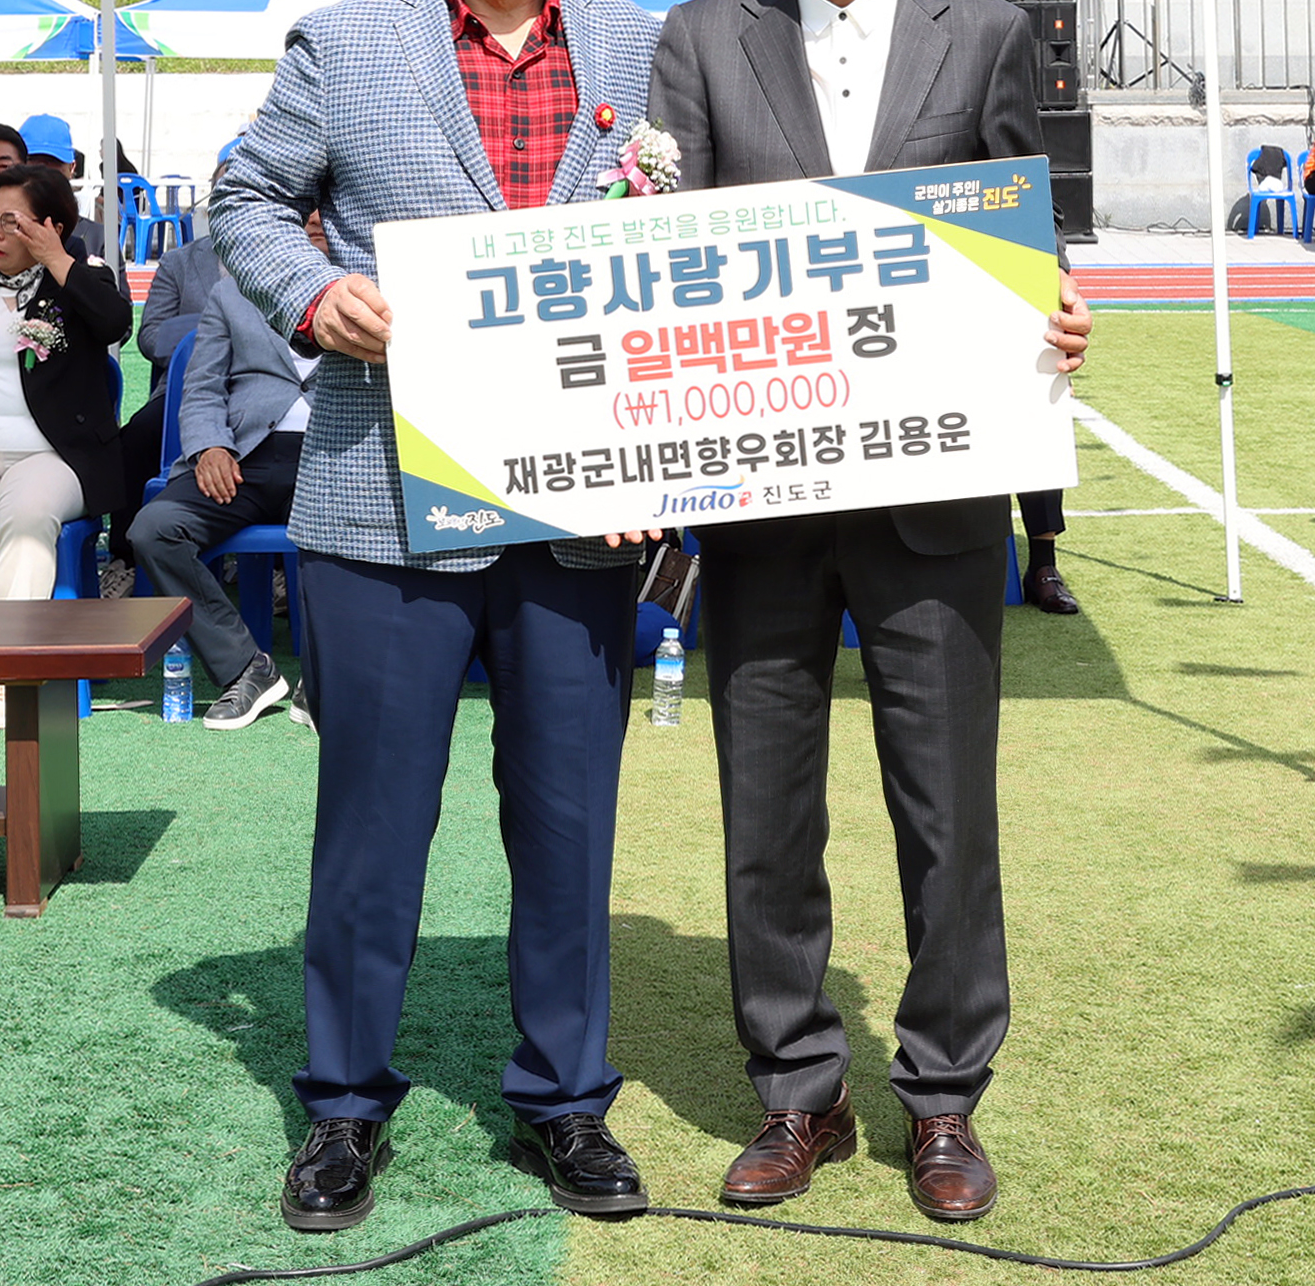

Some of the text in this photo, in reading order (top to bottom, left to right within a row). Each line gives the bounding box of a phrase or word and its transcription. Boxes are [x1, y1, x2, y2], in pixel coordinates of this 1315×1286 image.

[915, 179, 980, 201] 군민이 주인!
[932, 185, 1020, 215] 살기좋은 진도
[472, 199, 847, 259] 내 고향 진도 발전을 응원합니다.
[466, 222, 931, 330] 고향사랑기부금
[556, 304, 898, 389] 금 일백만원 정
[613, 369, 850, 429] (₩1,000,000)
[503, 411, 971, 496] 재광군내면향우회장 김용운
[653, 480, 833, 518] Jindo 진도군
